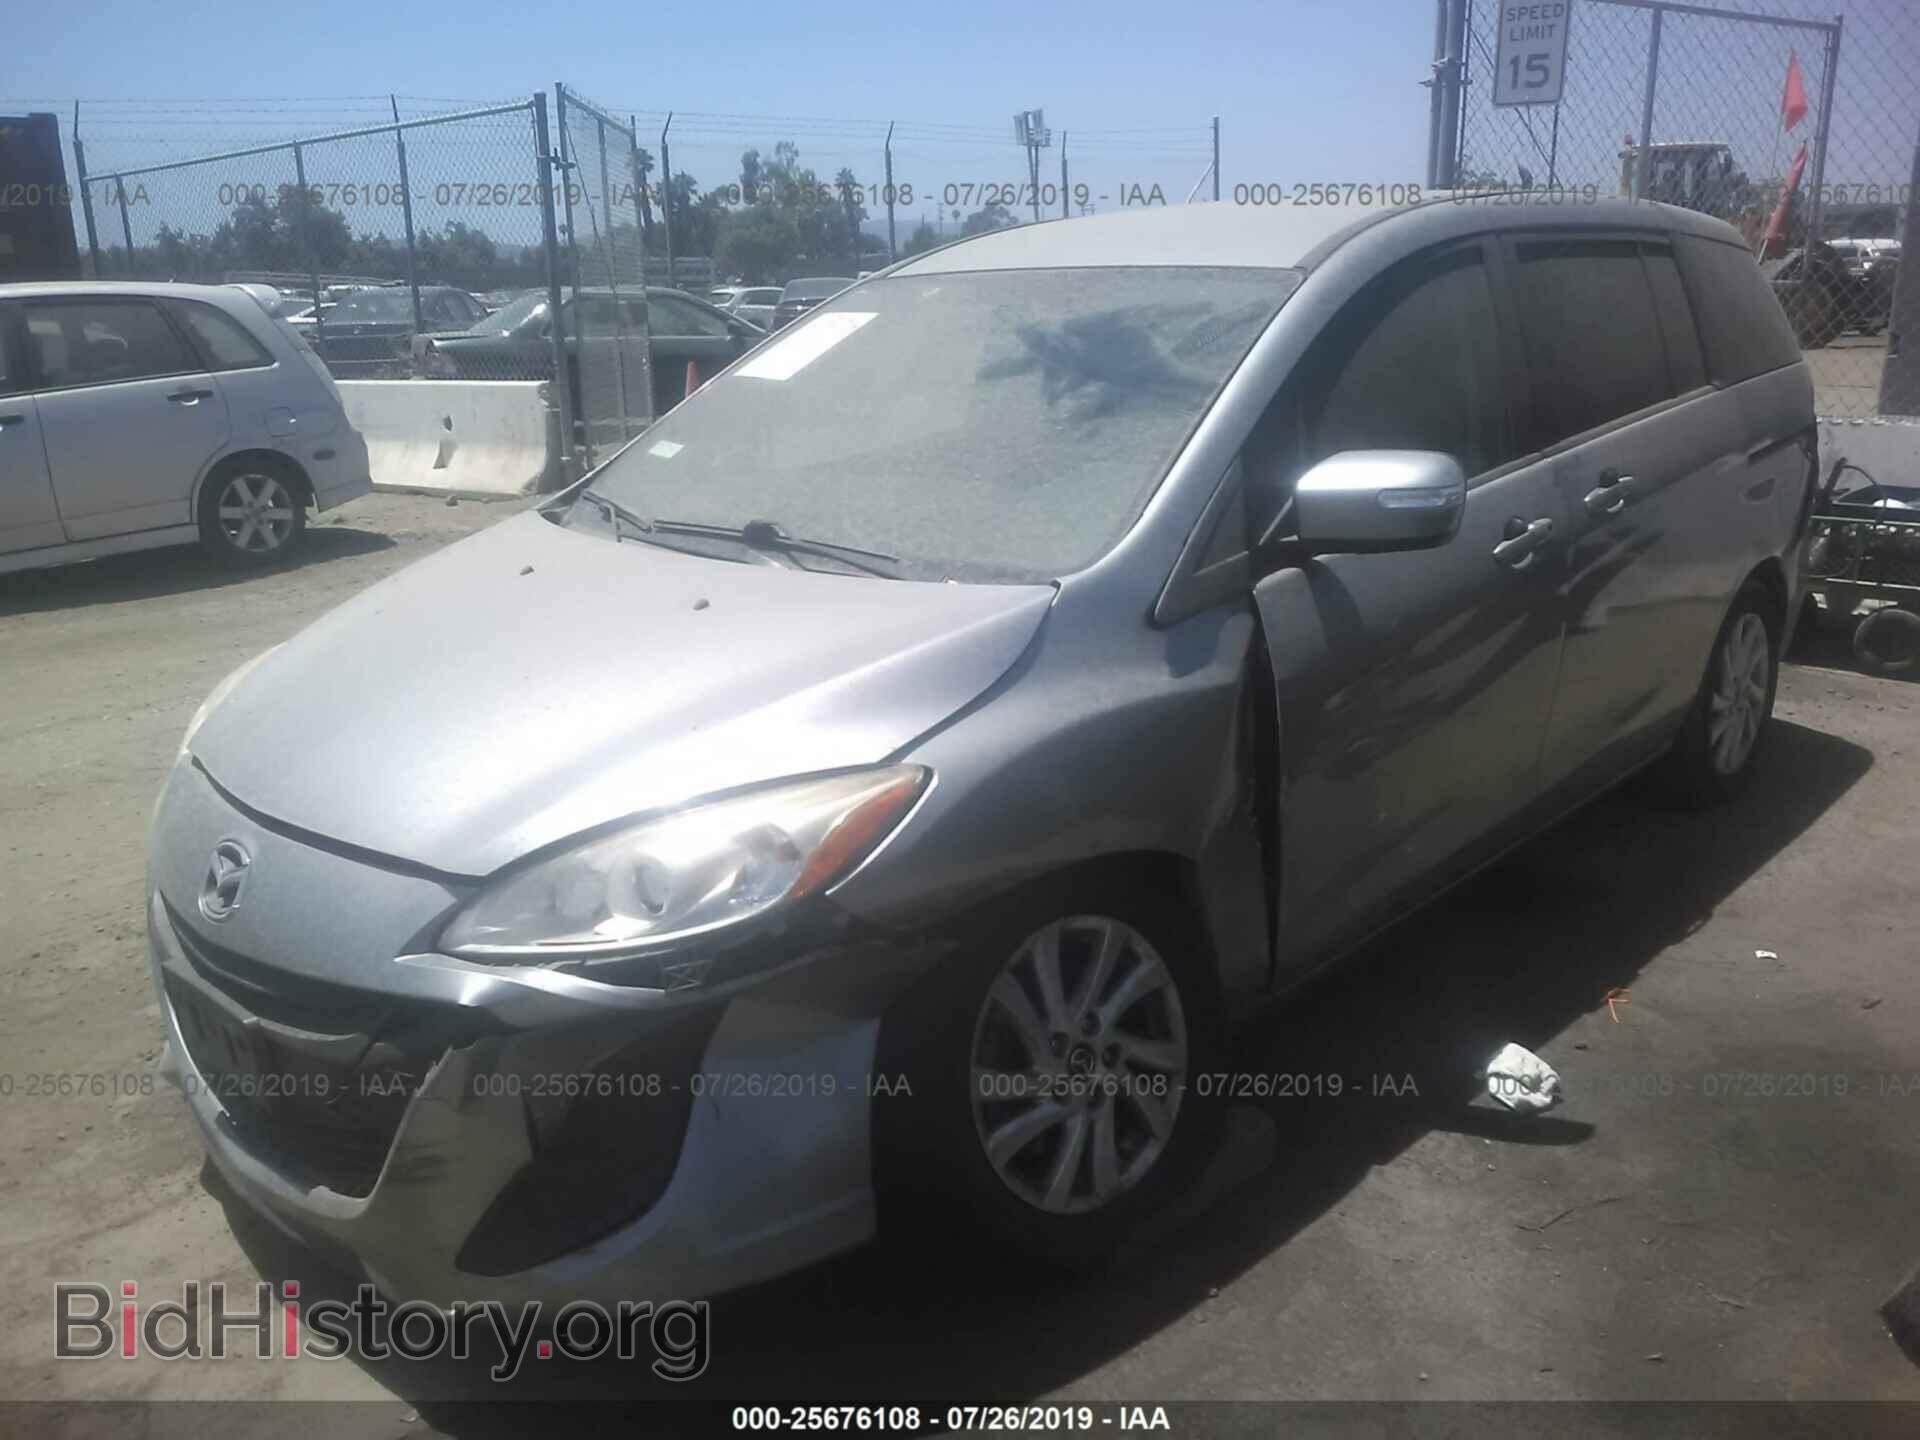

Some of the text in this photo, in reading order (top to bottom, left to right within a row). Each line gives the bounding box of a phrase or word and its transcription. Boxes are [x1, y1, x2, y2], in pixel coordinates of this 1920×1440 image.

[1507, 3, 1565, 22] SPEED
[1510, 23, 1557, 42] LIMIT
[1510, 53, 1551, 90] 15
